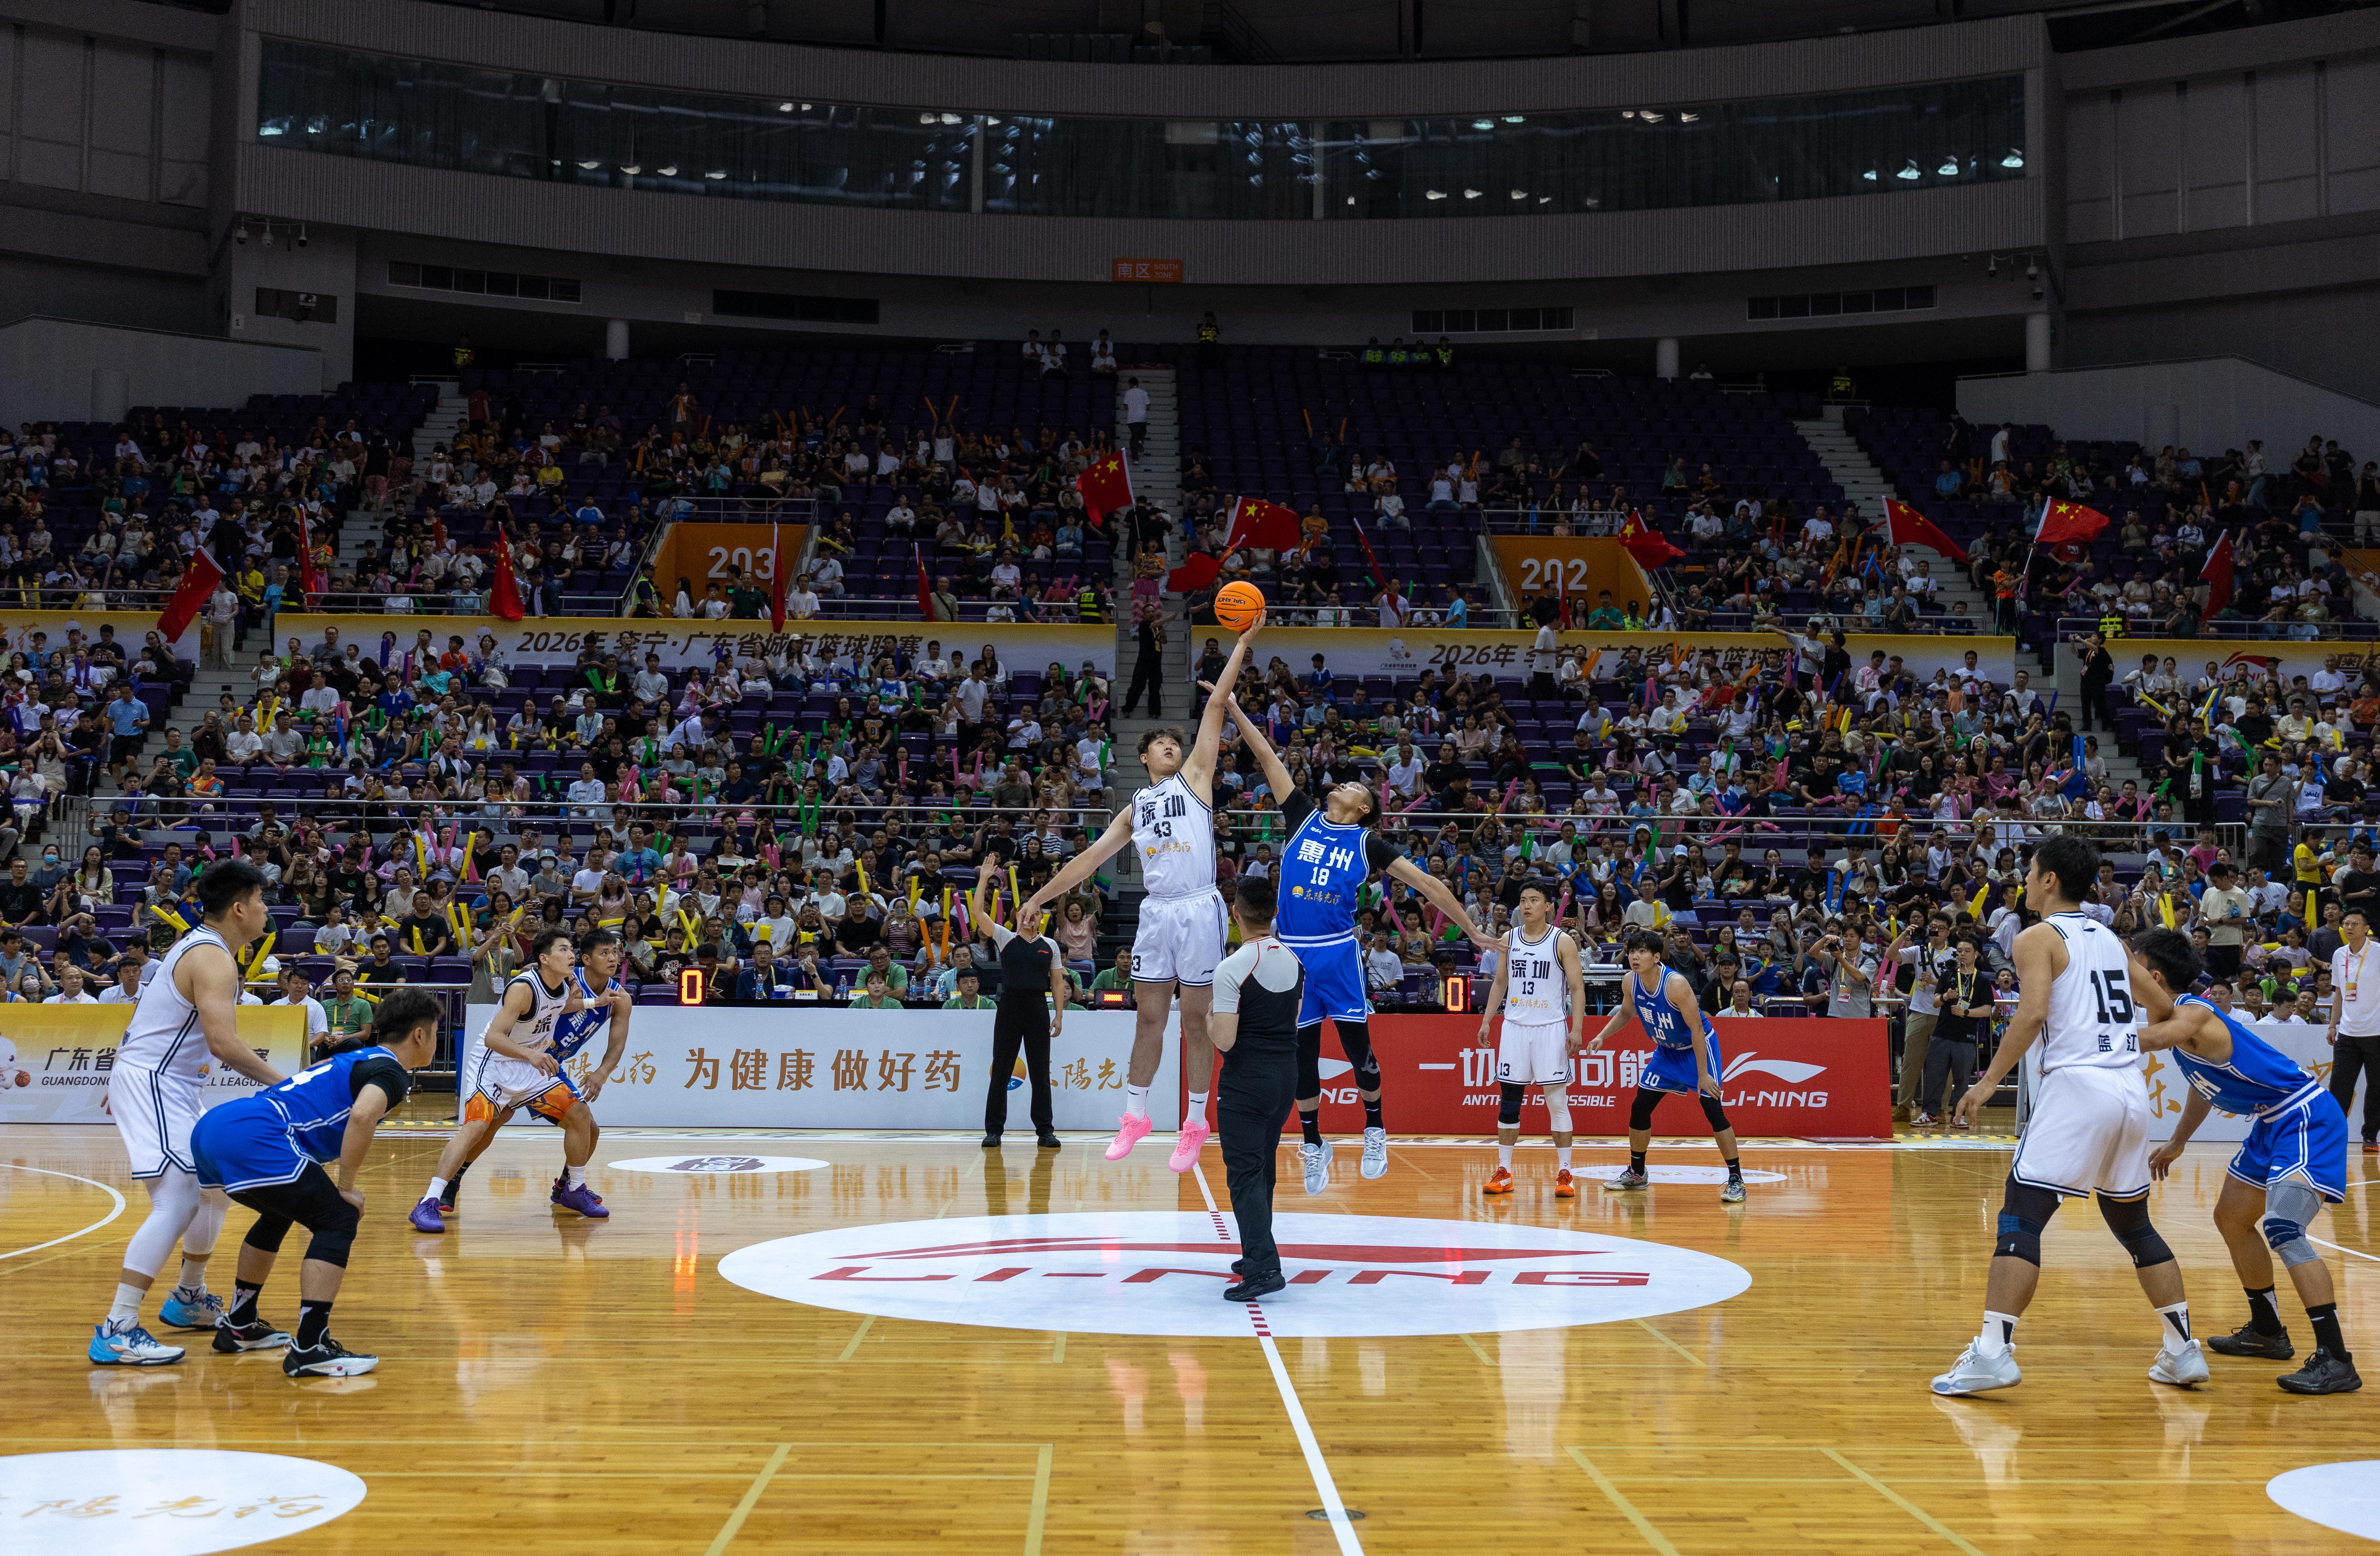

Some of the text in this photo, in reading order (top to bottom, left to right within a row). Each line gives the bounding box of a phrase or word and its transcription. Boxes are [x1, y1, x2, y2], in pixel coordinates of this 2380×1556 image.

[1117, 262, 1150, 278] 南区
[708, 546, 774, 579] 203
[1521, 558, 1587, 590] 202
[1428, 643, 1519, 668] 2026年
[870, 726, 876, 736] 8
[1142, 794, 1186, 827] 深圳
[1153, 821, 1172, 838] 43
[1297, 838, 1354, 872] 惠州
[1310, 866, 1330, 886] 18
[1511, 959, 1551, 980] 深圳
[682, 970, 702, 1004] 0
[1447, 977, 1464, 1011] 0
[1522, 981, 1535, 995] 13
[2090, 969, 2134, 1024] 15
[1638, 1005, 1674, 1029] 惠州
[1654, 1027, 1666, 1040] 10
[684, 1048, 961, 1092] 为健康 做好药
[1499, 1062, 1510, 1077] 13
[1644, 1071, 1660, 1087] 10
[810, 1266, 1650, 1286] LI-NING
